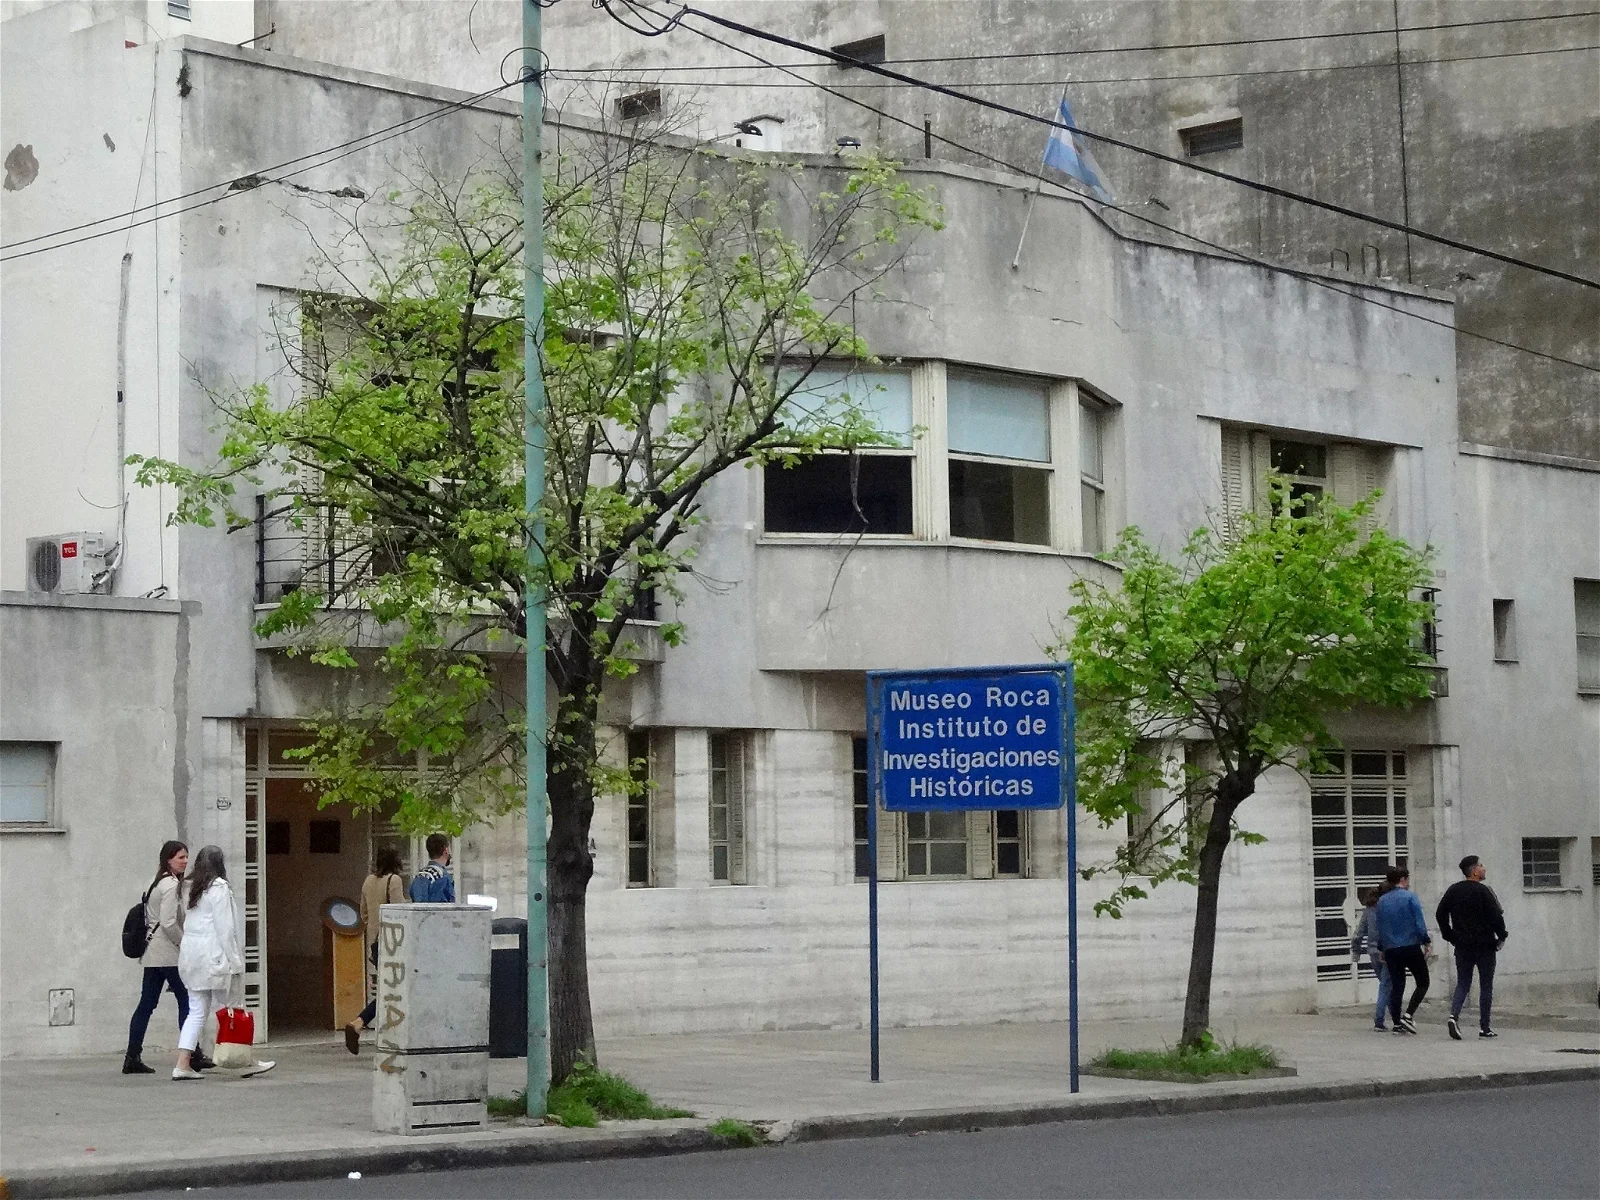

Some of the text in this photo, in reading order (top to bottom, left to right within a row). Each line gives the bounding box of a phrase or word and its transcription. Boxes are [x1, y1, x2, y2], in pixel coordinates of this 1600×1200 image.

[891, 686, 1050, 711] Museo Roca
[899, 715, 1047, 739] Instituto de
[883, 747, 1061, 774] Investigaciones
[910, 775, 1034, 798] Históricas
[378, 921, 407, 1075] BRIAN
